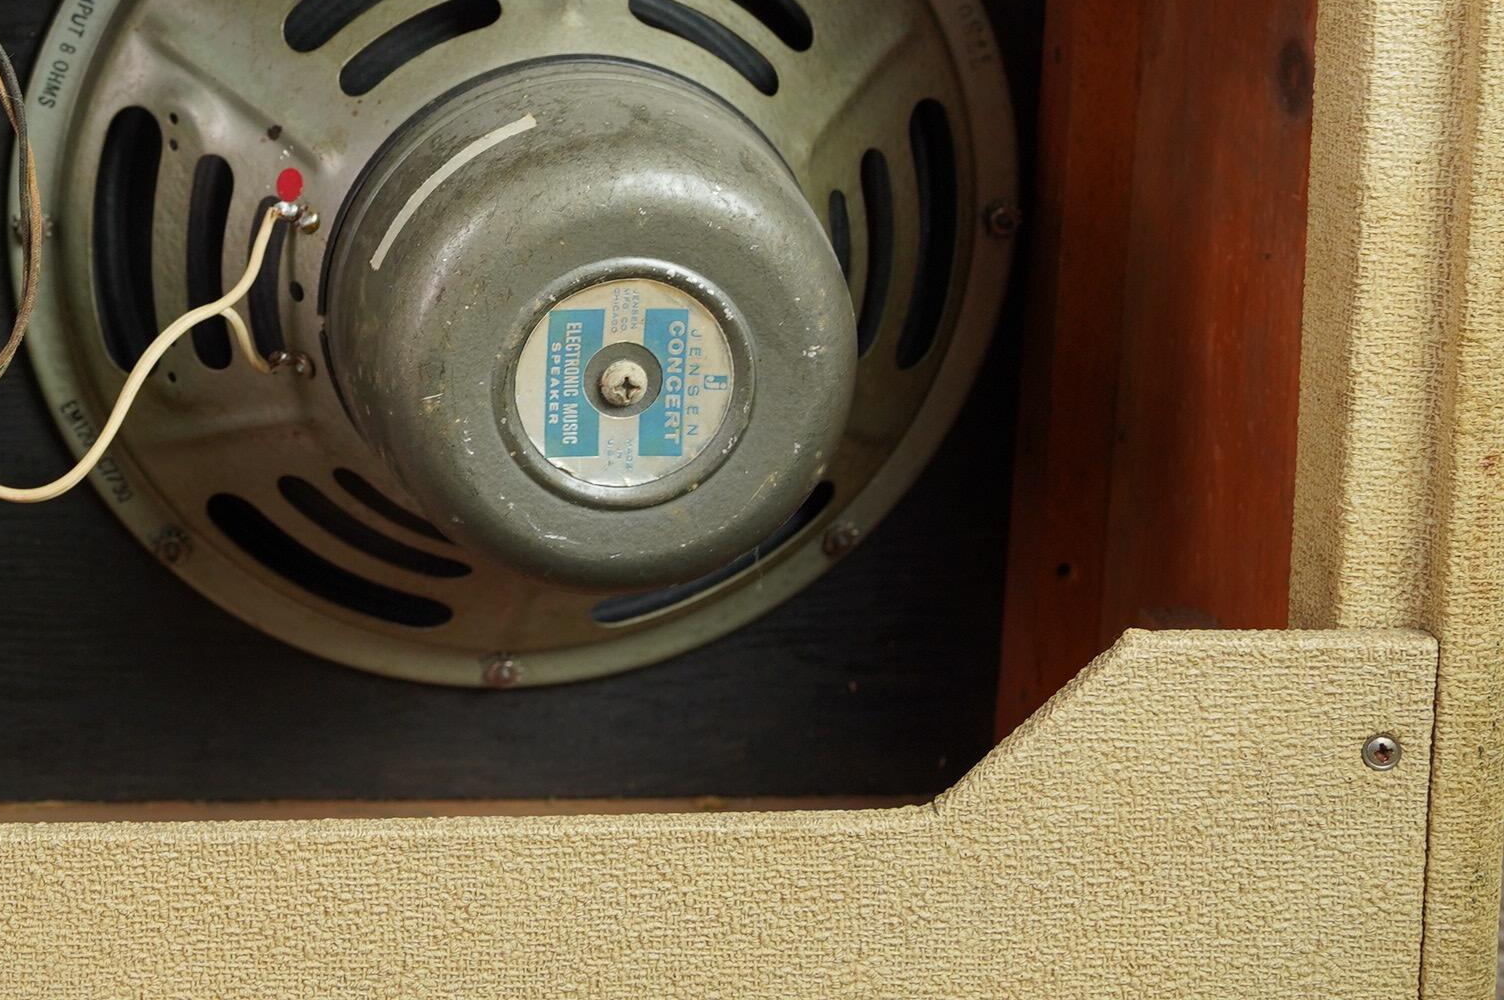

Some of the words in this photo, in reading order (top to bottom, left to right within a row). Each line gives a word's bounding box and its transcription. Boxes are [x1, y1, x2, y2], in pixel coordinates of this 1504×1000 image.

[38, 59, 70, 109] OHMS
[59, 42, 76, 55] 8
[548, 342, 562, 425] SPEAKER
[563, 321, 583, 398] ELECTRONIC
[664, 320, 686, 444] CONCERT
[686, 329, 703, 436] JENSEN
[561, 402, 579, 445] MUSIC
